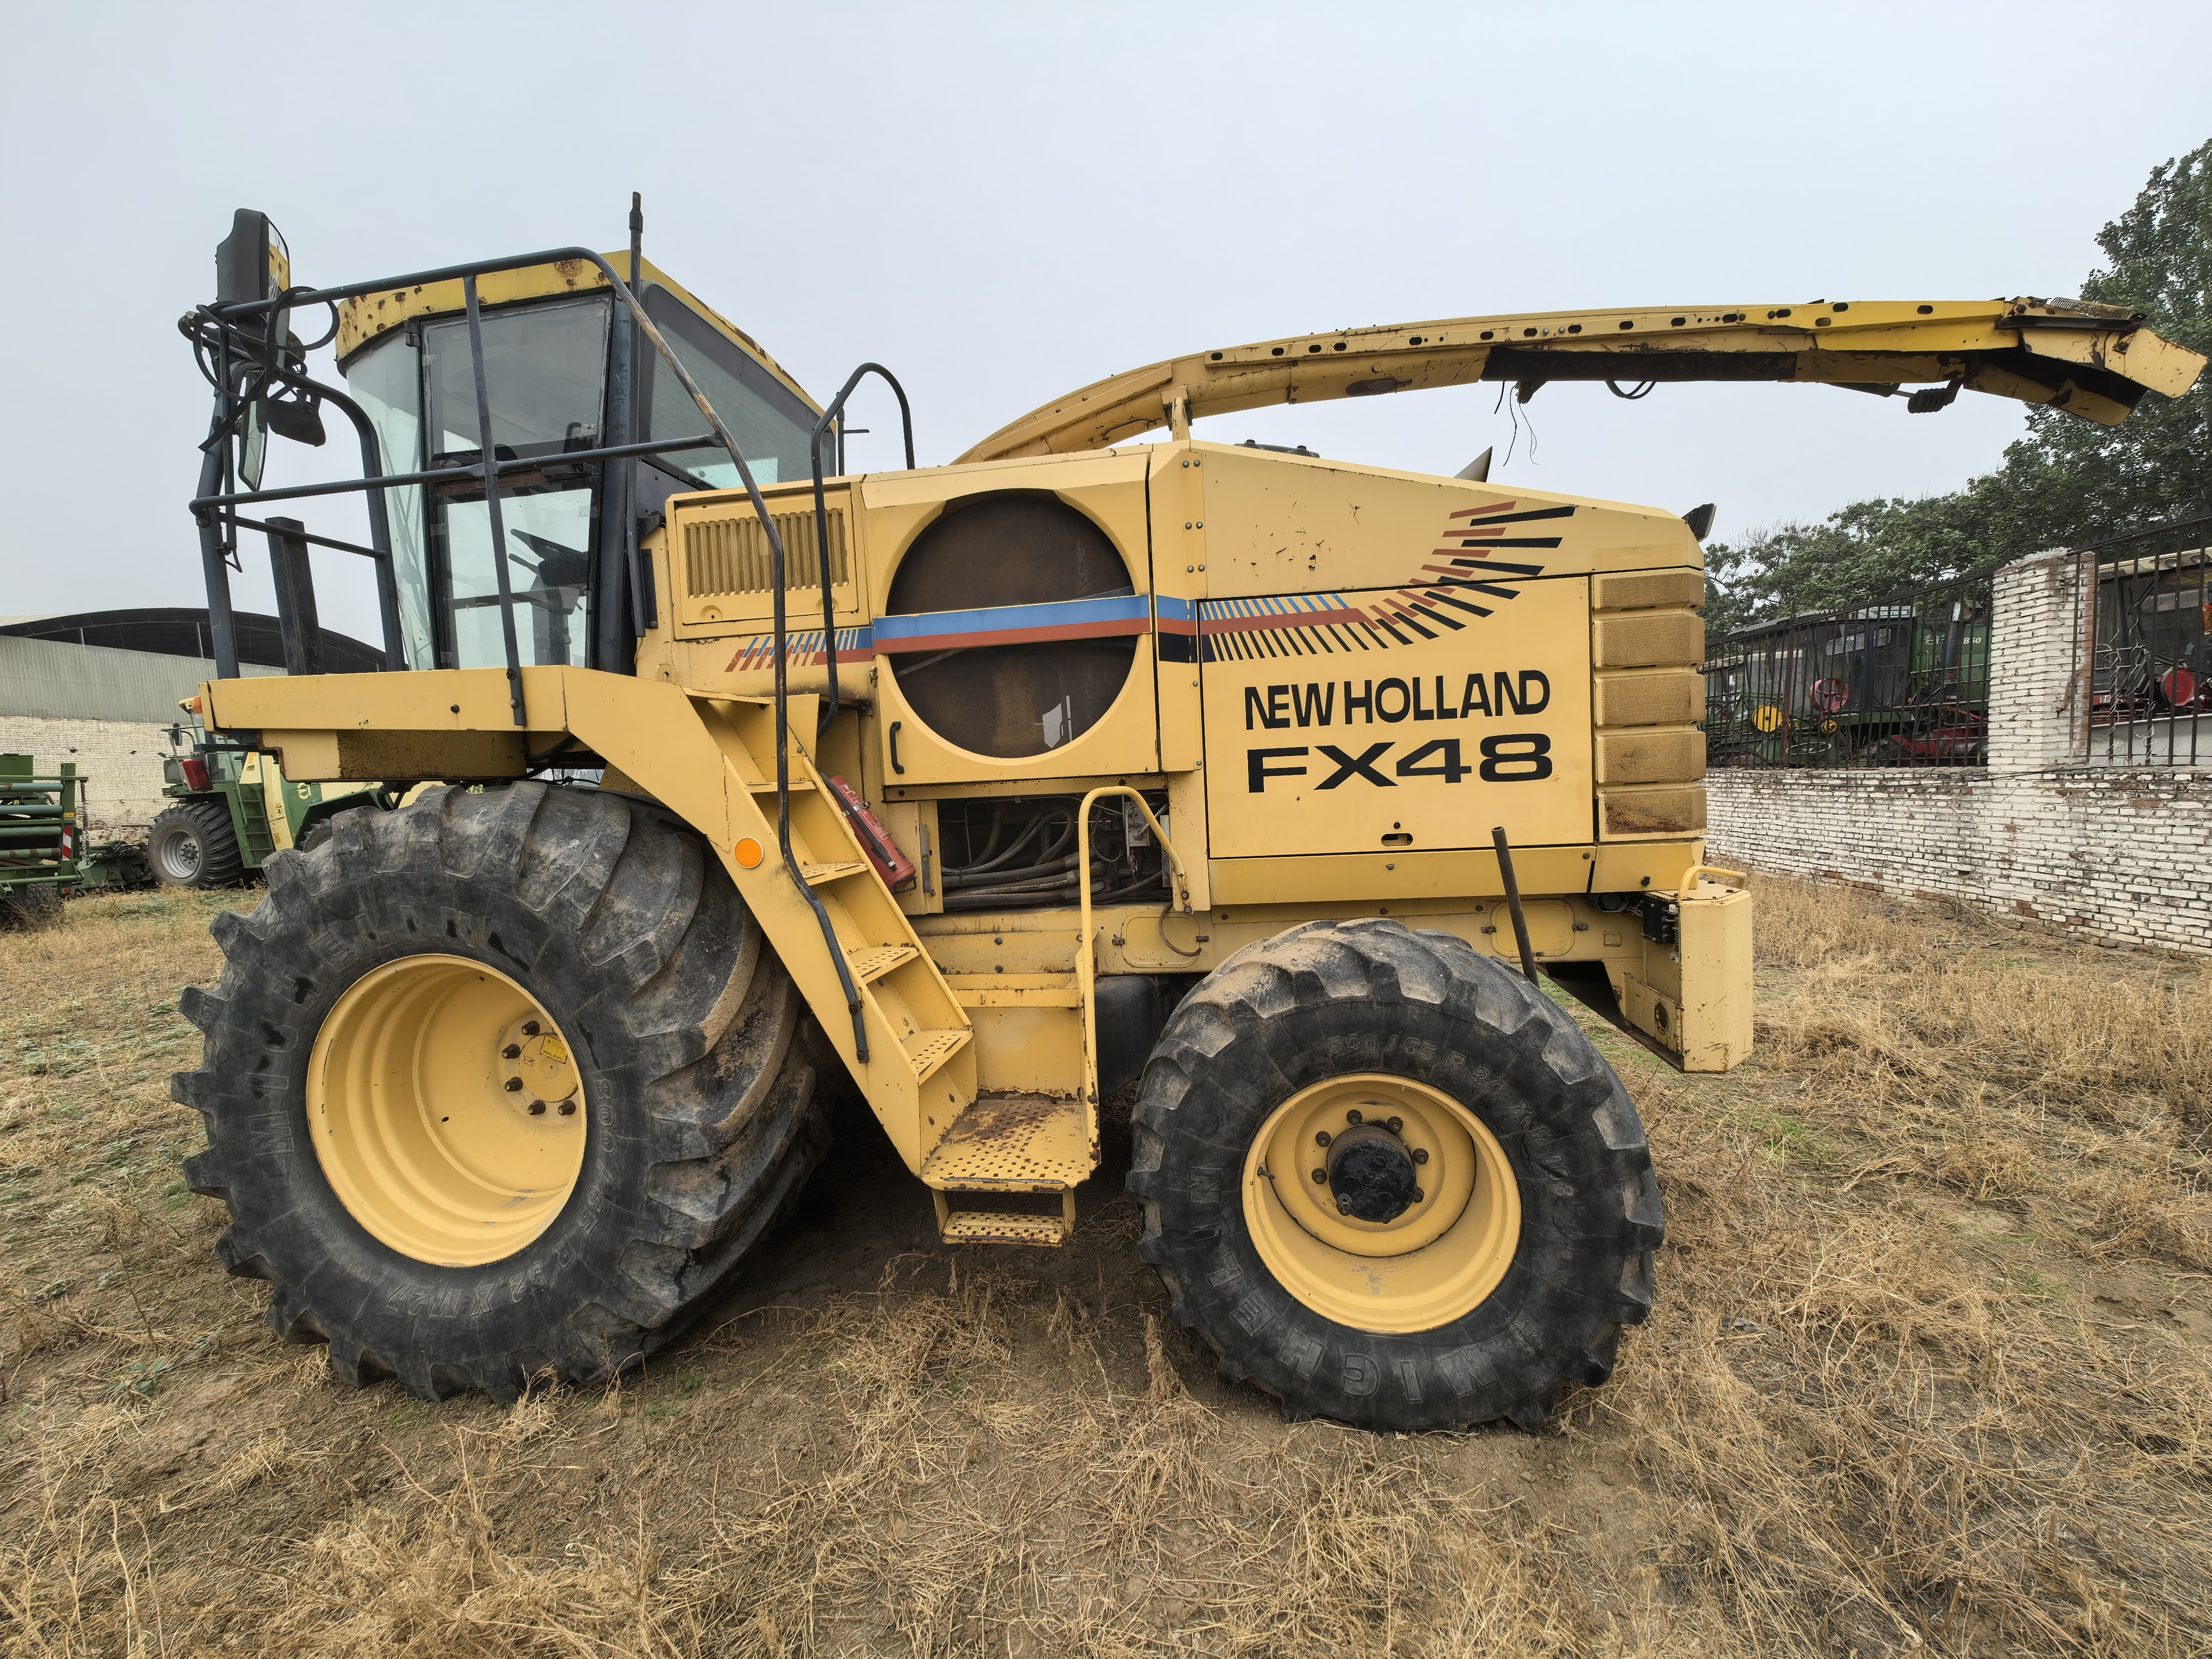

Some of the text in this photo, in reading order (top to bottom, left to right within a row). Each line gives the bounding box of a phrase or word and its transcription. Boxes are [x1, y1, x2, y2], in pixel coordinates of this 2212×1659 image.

[1244, 669, 1551, 730] NEW HOLLAND
[1247, 733, 1553, 793] FX48
[1188, 1166, 1499, 1403] MICHELIN
